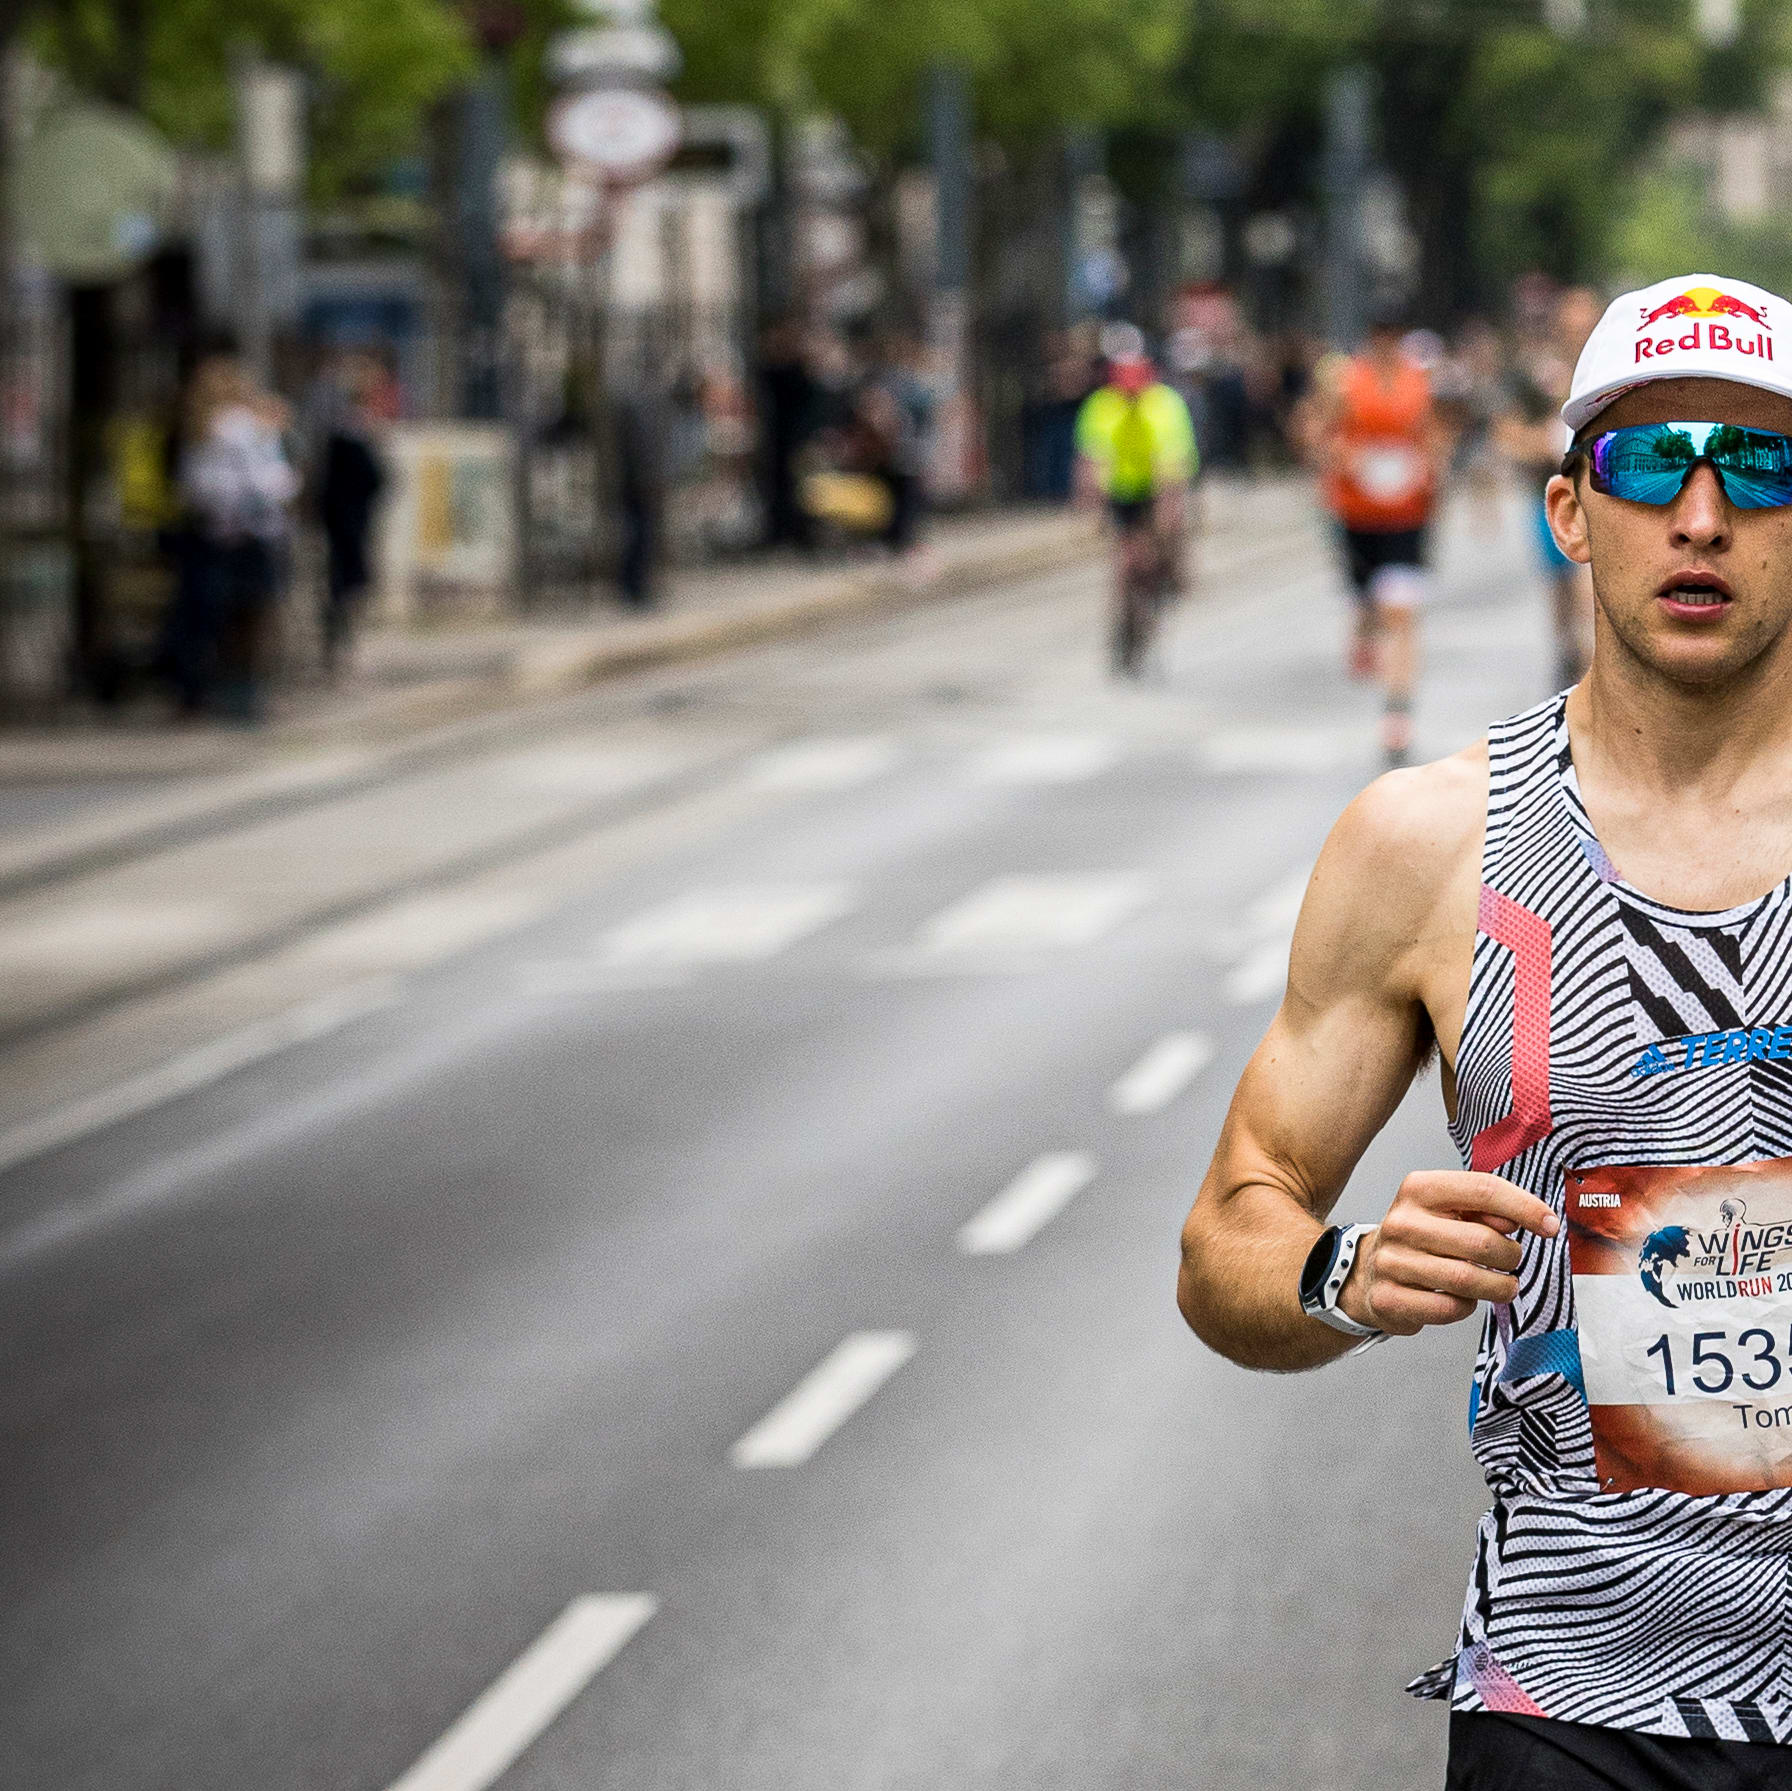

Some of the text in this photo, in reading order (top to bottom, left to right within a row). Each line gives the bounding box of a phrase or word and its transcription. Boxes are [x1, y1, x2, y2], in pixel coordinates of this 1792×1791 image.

[1635, 322, 1773, 364] Red Bull
[1578, 1193, 1621, 1208] AUSTRIA
[1694, 1250, 1776, 1276] FOR LIFE
